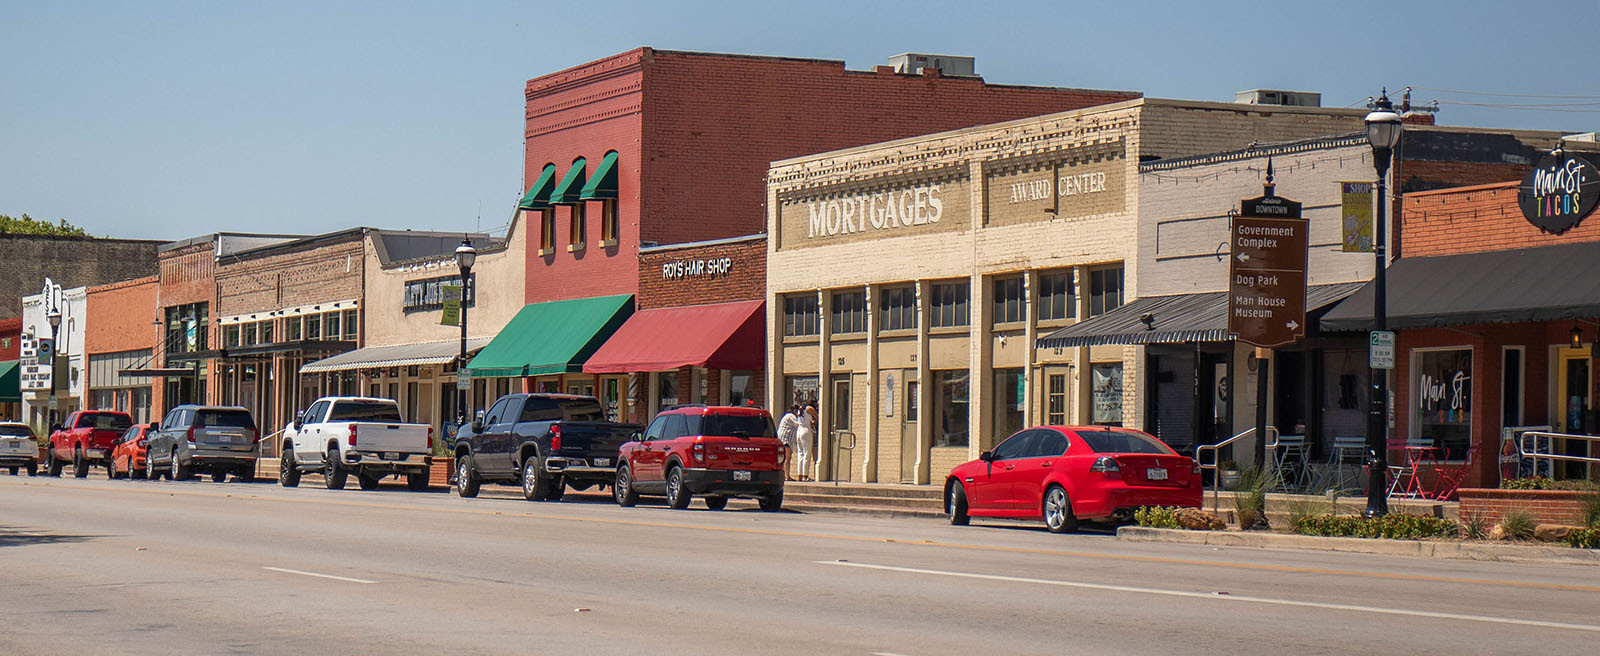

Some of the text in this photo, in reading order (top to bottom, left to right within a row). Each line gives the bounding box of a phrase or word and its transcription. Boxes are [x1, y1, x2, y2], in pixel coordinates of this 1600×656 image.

[1009, 171, 1107, 204] AWARD CENTER
[1350, 183, 1370, 194] SHOP
[1534, 166, 1565, 198] Main
[1255, 205, 1288, 214] DOWNTOWN
[1537, 192, 1580, 218] TACOS
[808, 185, 943, 239] MORTGAGES
[1238, 224, 1294, 236] Government
[1238, 236, 1278, 249] Complex
[685, 260, 705, 275] HAIR
[707, 257, 731, 274] SHOP
[1236, 274, 1279, 287] Dog Park
[1235, 295, 1286, 307] Man House
[1235, 307, 1273, 318] Museum
[1372, 333, 1379, 345] 2
[1420, 374, 1446, 411] Main
